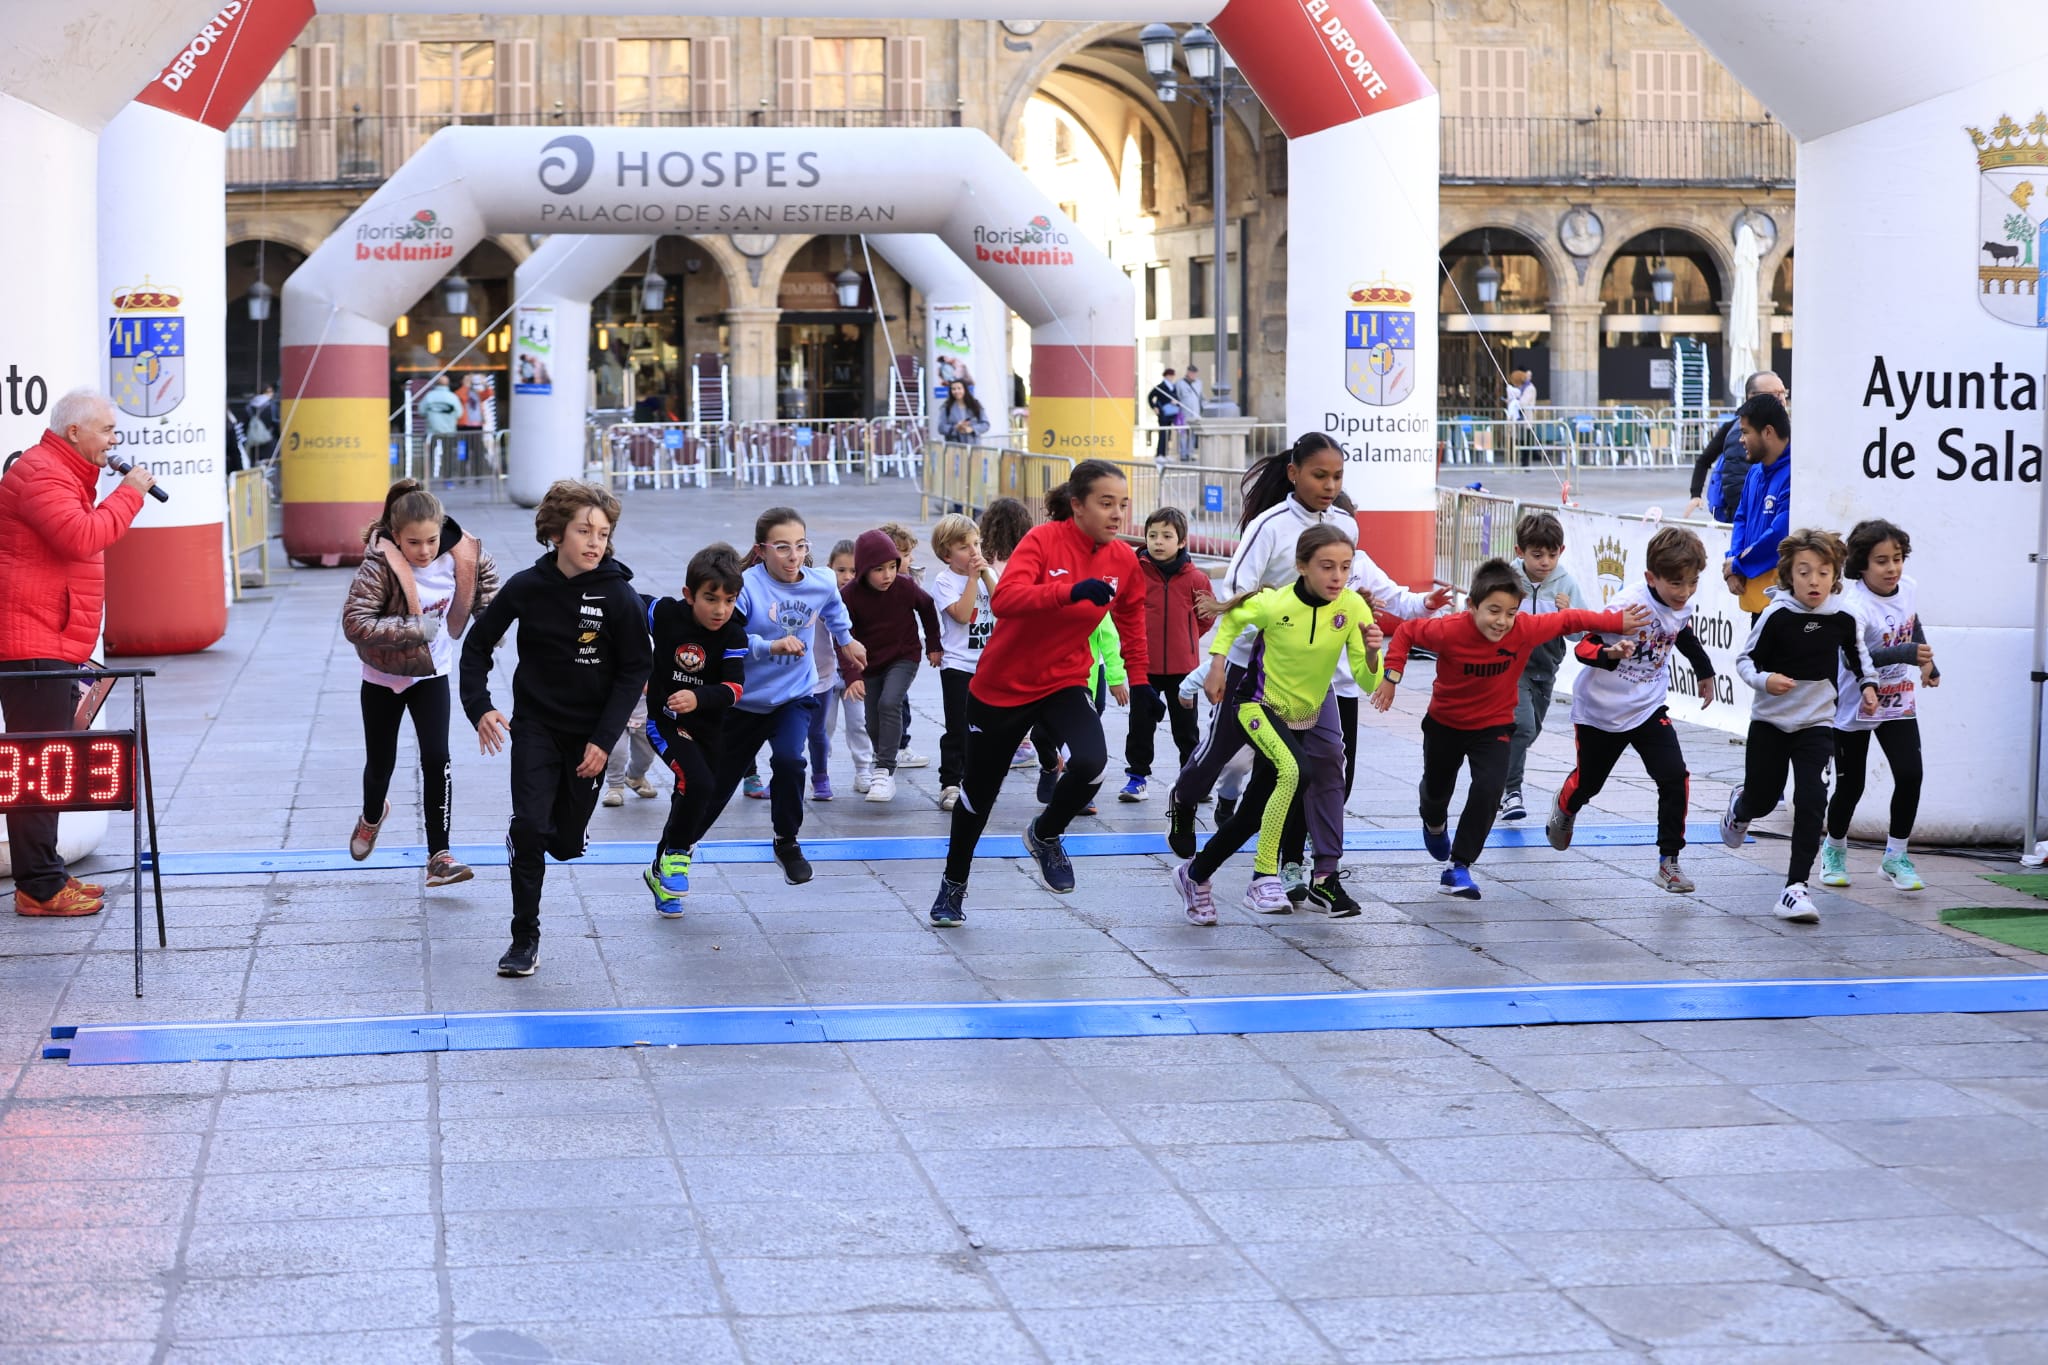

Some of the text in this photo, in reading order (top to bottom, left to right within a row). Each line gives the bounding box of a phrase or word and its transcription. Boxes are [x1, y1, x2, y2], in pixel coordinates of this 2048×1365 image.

[161, 0, 246, 93] DEPORTIS
[1305, 0, 1388, 99] EL DEPORTE
[616, 151, 821, 188] HOSPES
[540, 204, 895, 223] PALACIO DE SAN ESTEBAN
[355, 241, 454, 261] bedunia
[975, 244, 1074, 265] bedunia
[0, 365, 48, 416] to
[1862, 355, 2046, 421] Ayunta
[113, 421, 207, 449] putación
[1324, 411, 1430, 437] Diputación
[303, 436, 361, 449] HOSPES
[1060, 435, 1115, 447] HOSPES
[1862, 427, 1915, 479] de
[106, 456, 213, 478] lamanca
[779, 599, 813, 617] ALOHA
